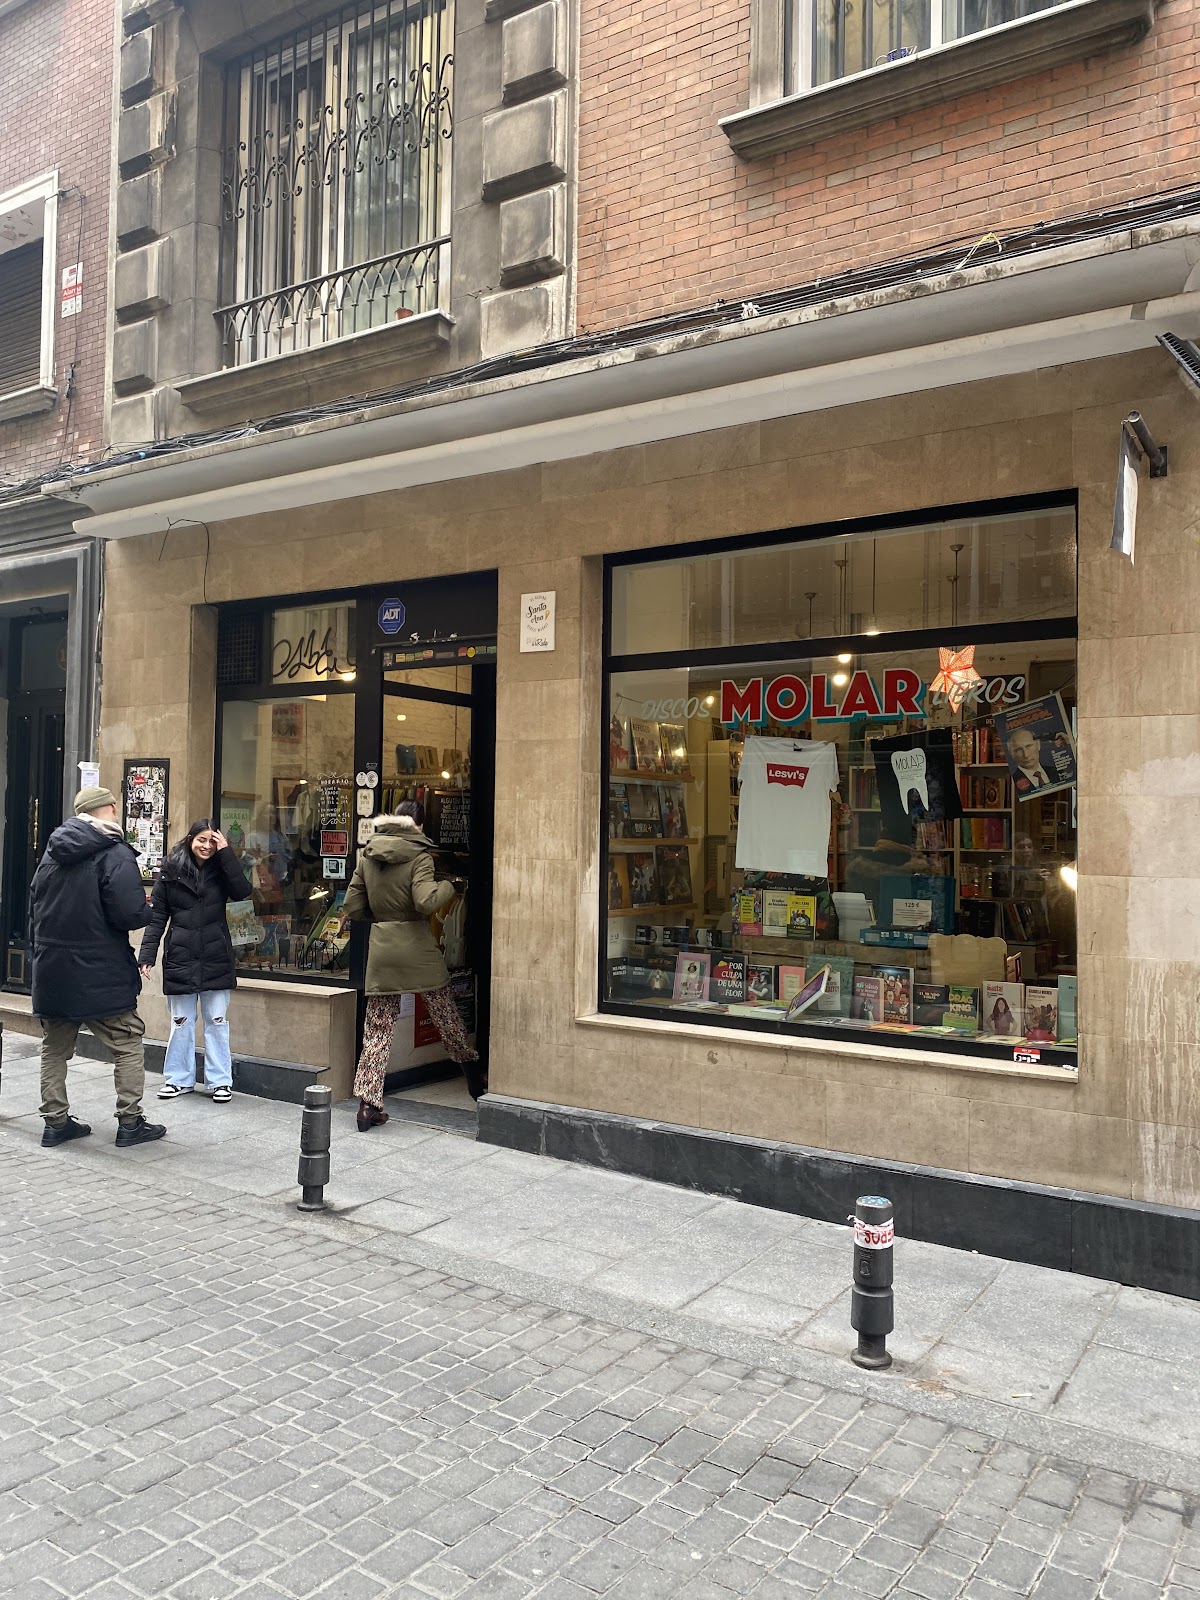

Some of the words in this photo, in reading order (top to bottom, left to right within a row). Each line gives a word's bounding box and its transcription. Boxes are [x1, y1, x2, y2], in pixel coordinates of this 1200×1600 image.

[382, 607, 400, 621] ADT
[526, 603, 547, 618] Santa
[931, 676, 1026, 705] LIBROS
[719, 668, 928, 726] MOLAR
[640, 697, 711, 720] DISCOS
[894, 754, 925, 771] MOLAR
[729, 961, 743, 971] POR
[721, 971, 743, 980] CULPA
[717, 979, 727, 988] DE
[727, 981, 743, 989] UNA
[725, 989, 743, 998] FLOR
[949, 994, 973, 1005] DRAG
[949, 1004, 972, 1012] KING
